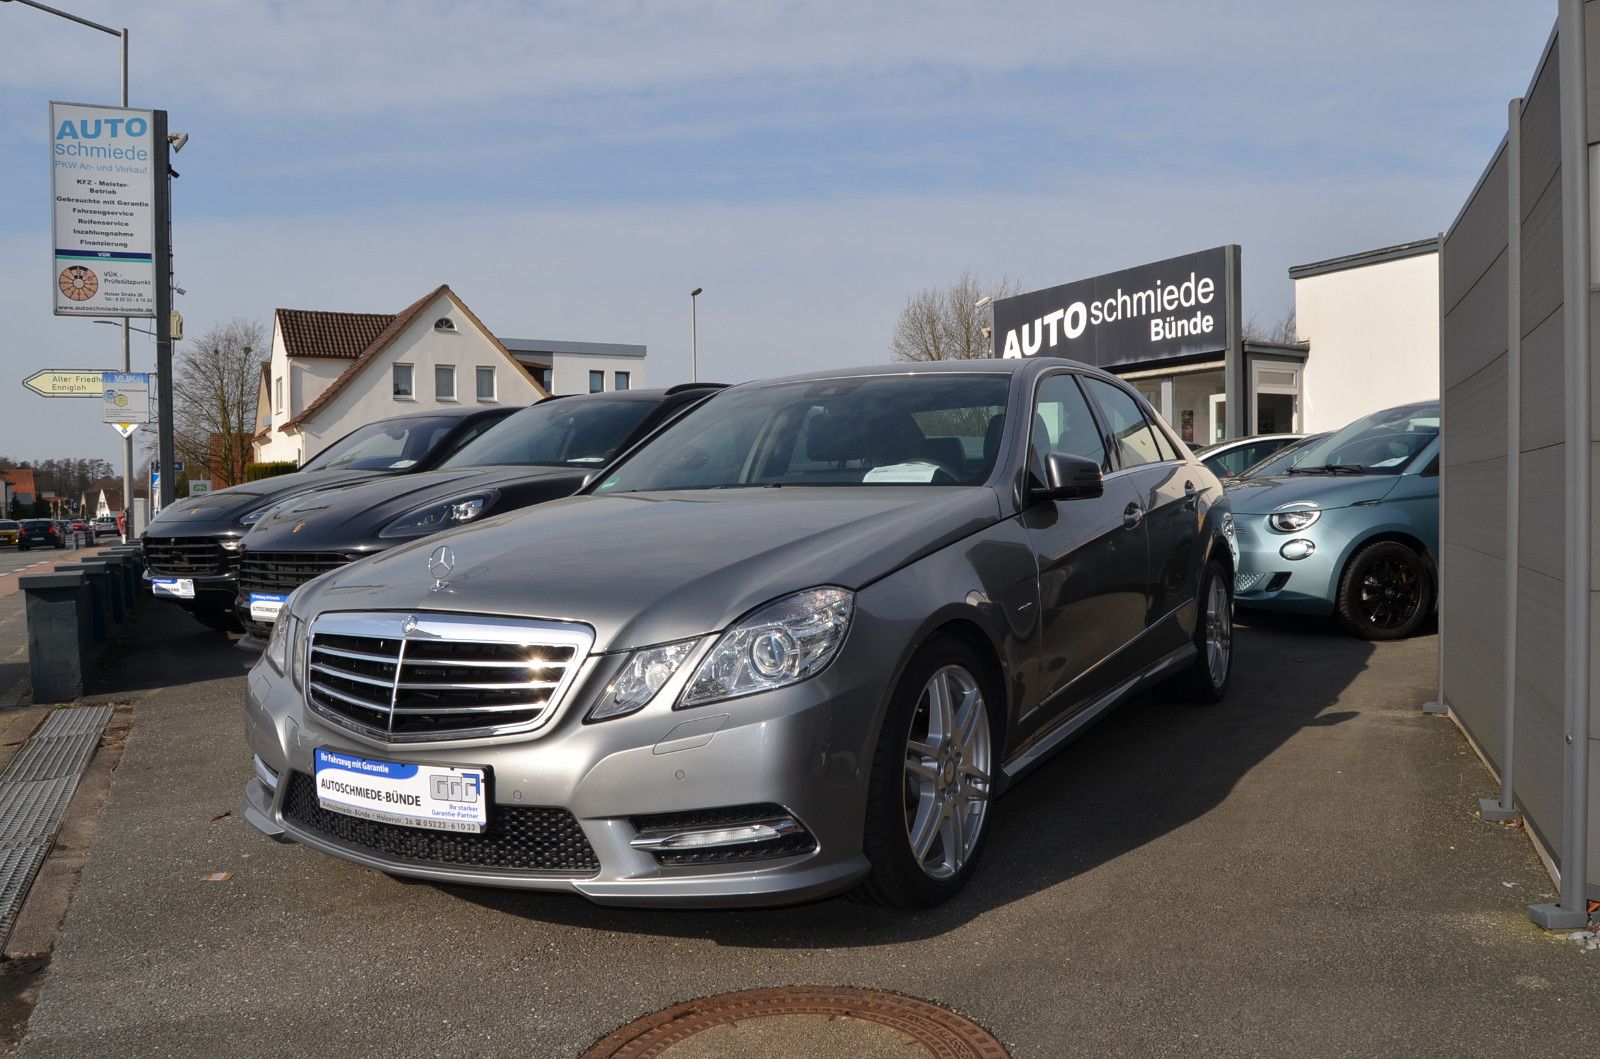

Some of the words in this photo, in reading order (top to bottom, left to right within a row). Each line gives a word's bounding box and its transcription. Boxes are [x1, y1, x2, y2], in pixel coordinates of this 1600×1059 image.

[56, 117, 147, 140] AUTO
[55, 140, 148, 161] schmiede
[55, 160, 78, 169] PKW
[79, 162, 94, 171] An-
[97, 163, 113, 172] und
[116, 165, 148, 174] Verkauf
[99, 180, 129, 188] Meister-
[56, 196, 100, 205] Gebrauchte
[72, 208, 134, 217] Fahrzeugservice
[77, 219, 129, 227] Reifenservice
[73, 229, 134, 237] Inzahlungnahme
[80, 240, 128, 248] Finanzierung
[1002, 301, 1088, 359] AUTO
[1090, 271, 1215, 325] schmiede
[1150, 311, 1214, 342] Bünde
[52, 384, 87, 392] Ennigloh
[320, 752, 328, 761] Ihr
[328, 754, 352, 769] Fahrzeug
[351, 759, 362, 769] mit
[362, 761, 390, 774] Garantie
[321, 778, 422, 807] AUTOSCHMIEDE-BÜNDE
[458, 804, 479, 812] starker
[431, 809, 479, 819] Garantie-Partner
[405, 817, 414, 825] 26
